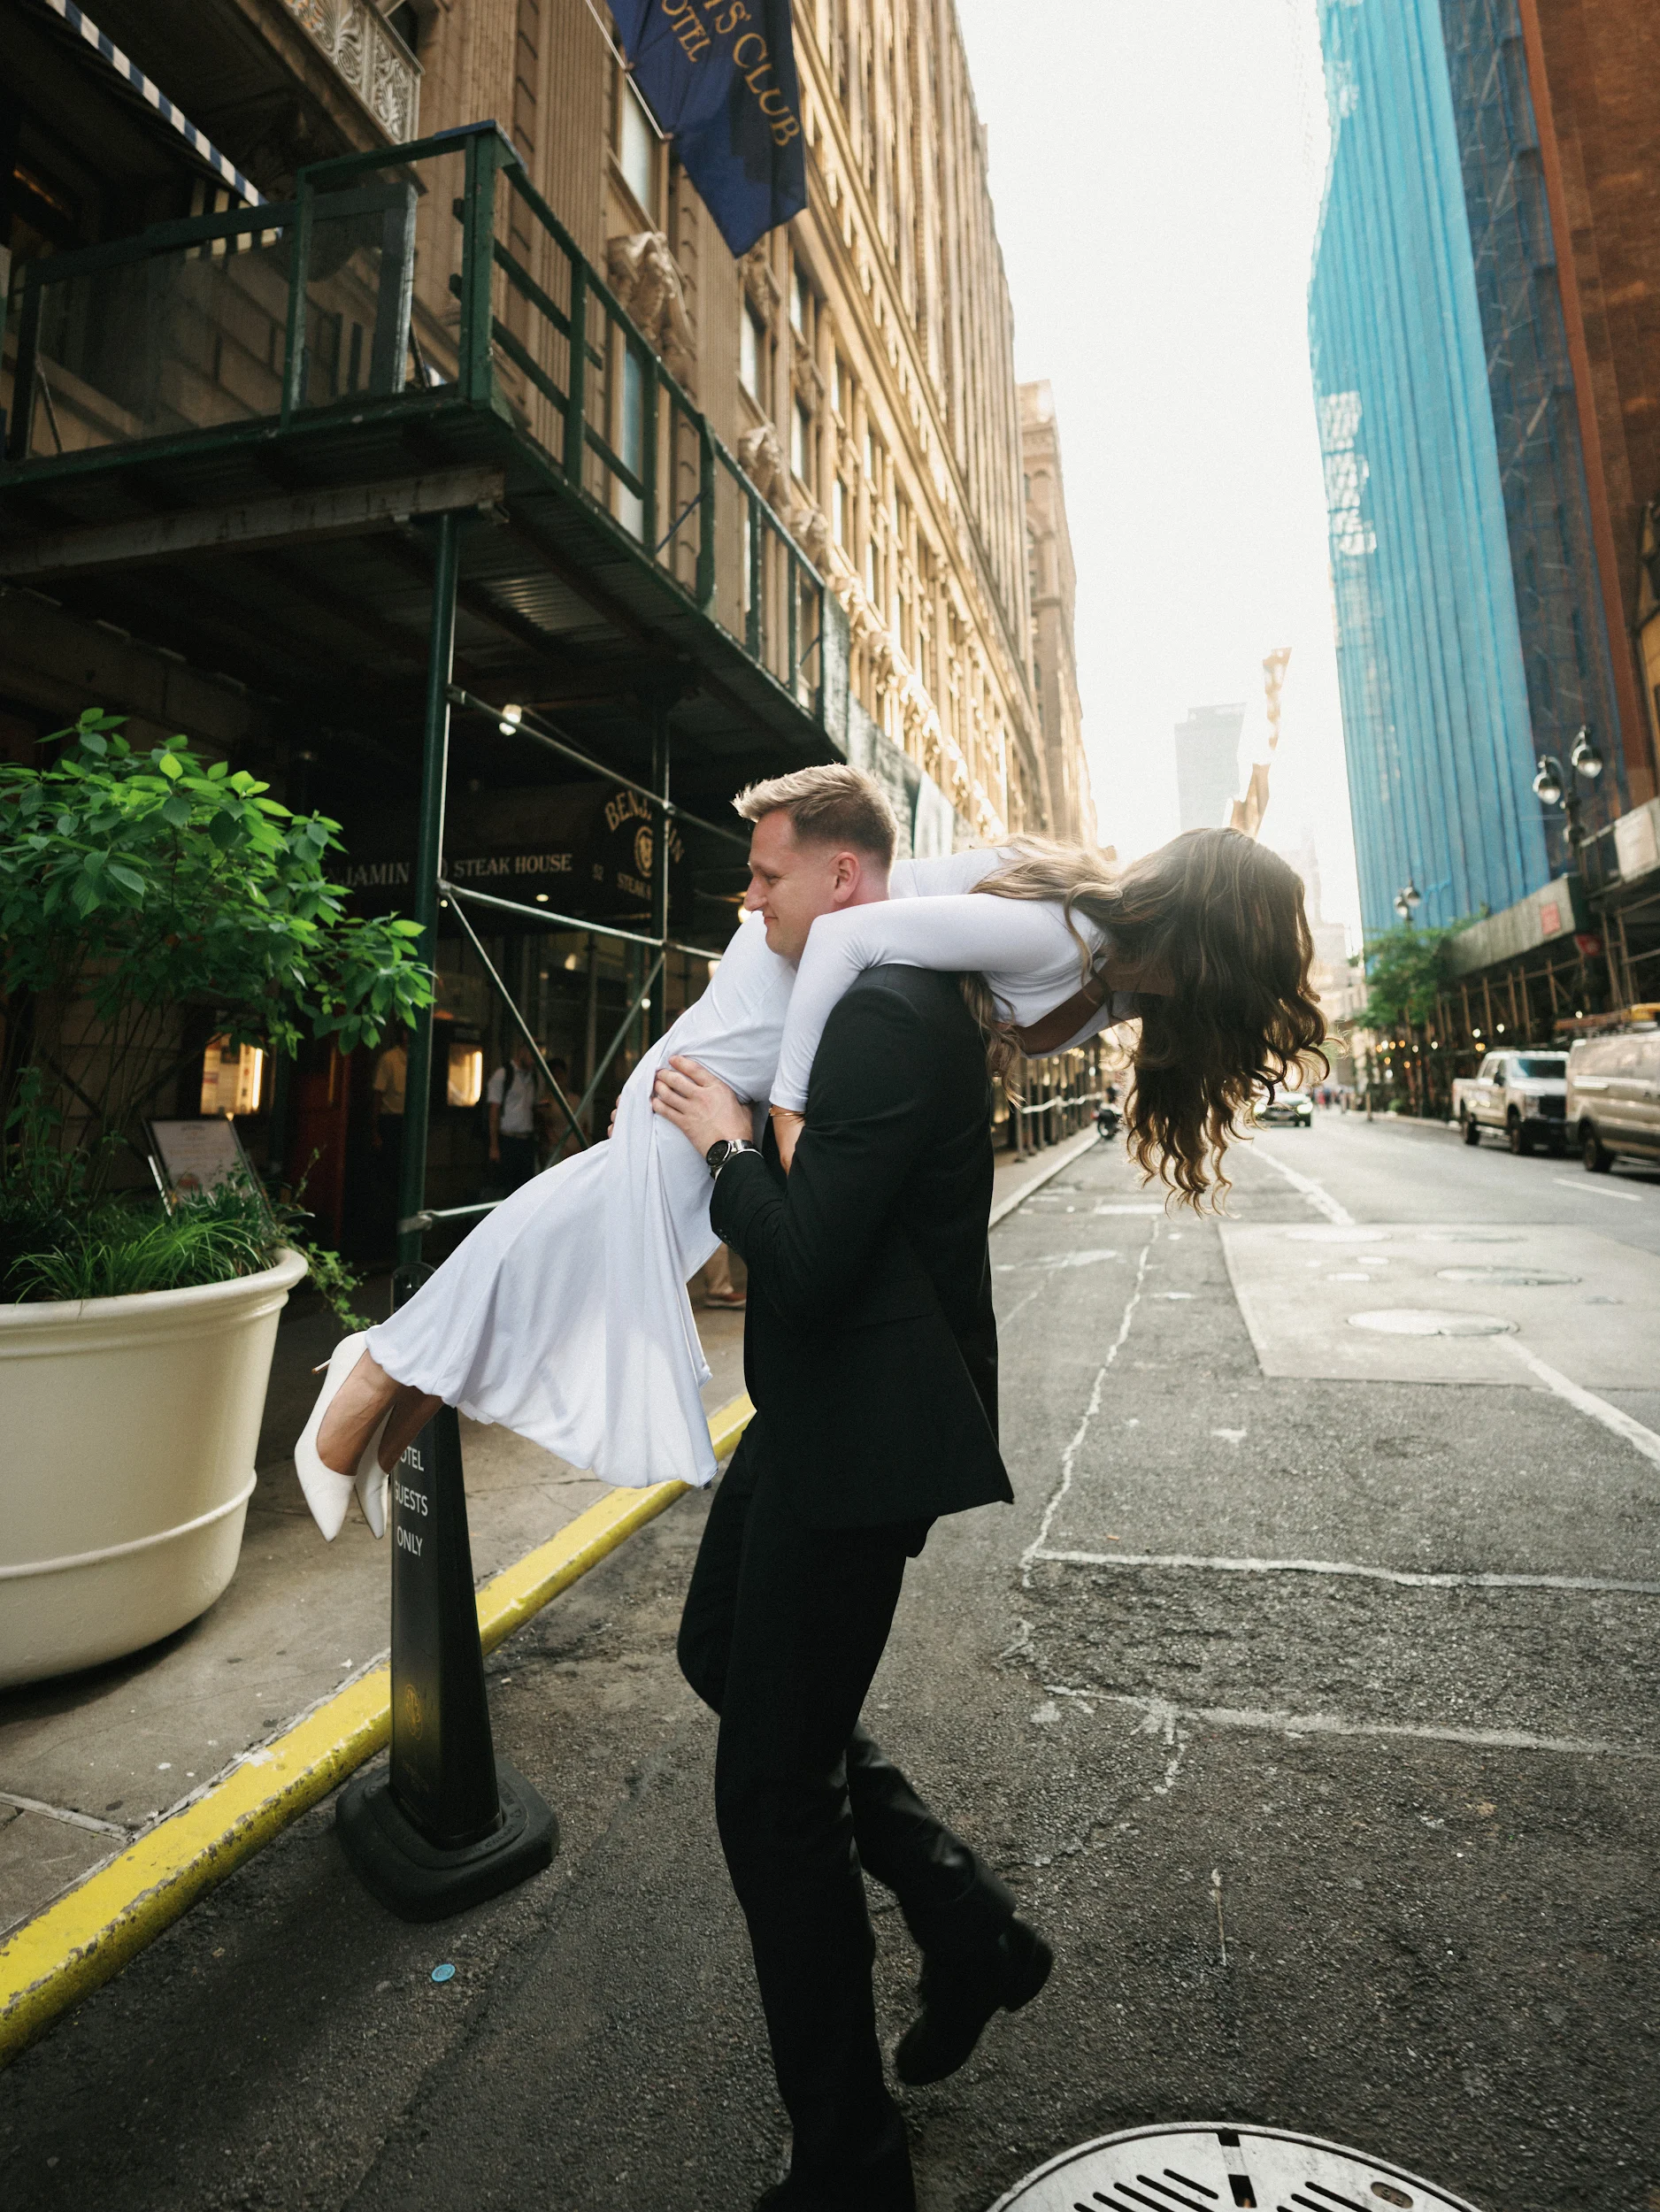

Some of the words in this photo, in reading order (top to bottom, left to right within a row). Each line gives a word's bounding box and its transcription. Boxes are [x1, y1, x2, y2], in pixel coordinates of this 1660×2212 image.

[661, 0, 711, 63] OTEL
[732, 32, 800, 146] CLUB
[453, 856, 511, 878] STEAK
[515, 853, 573, 875] HOUSE
[400, 1446, 425, 1471] OTEL
[397, 1525, 423, 1556] ONLY
